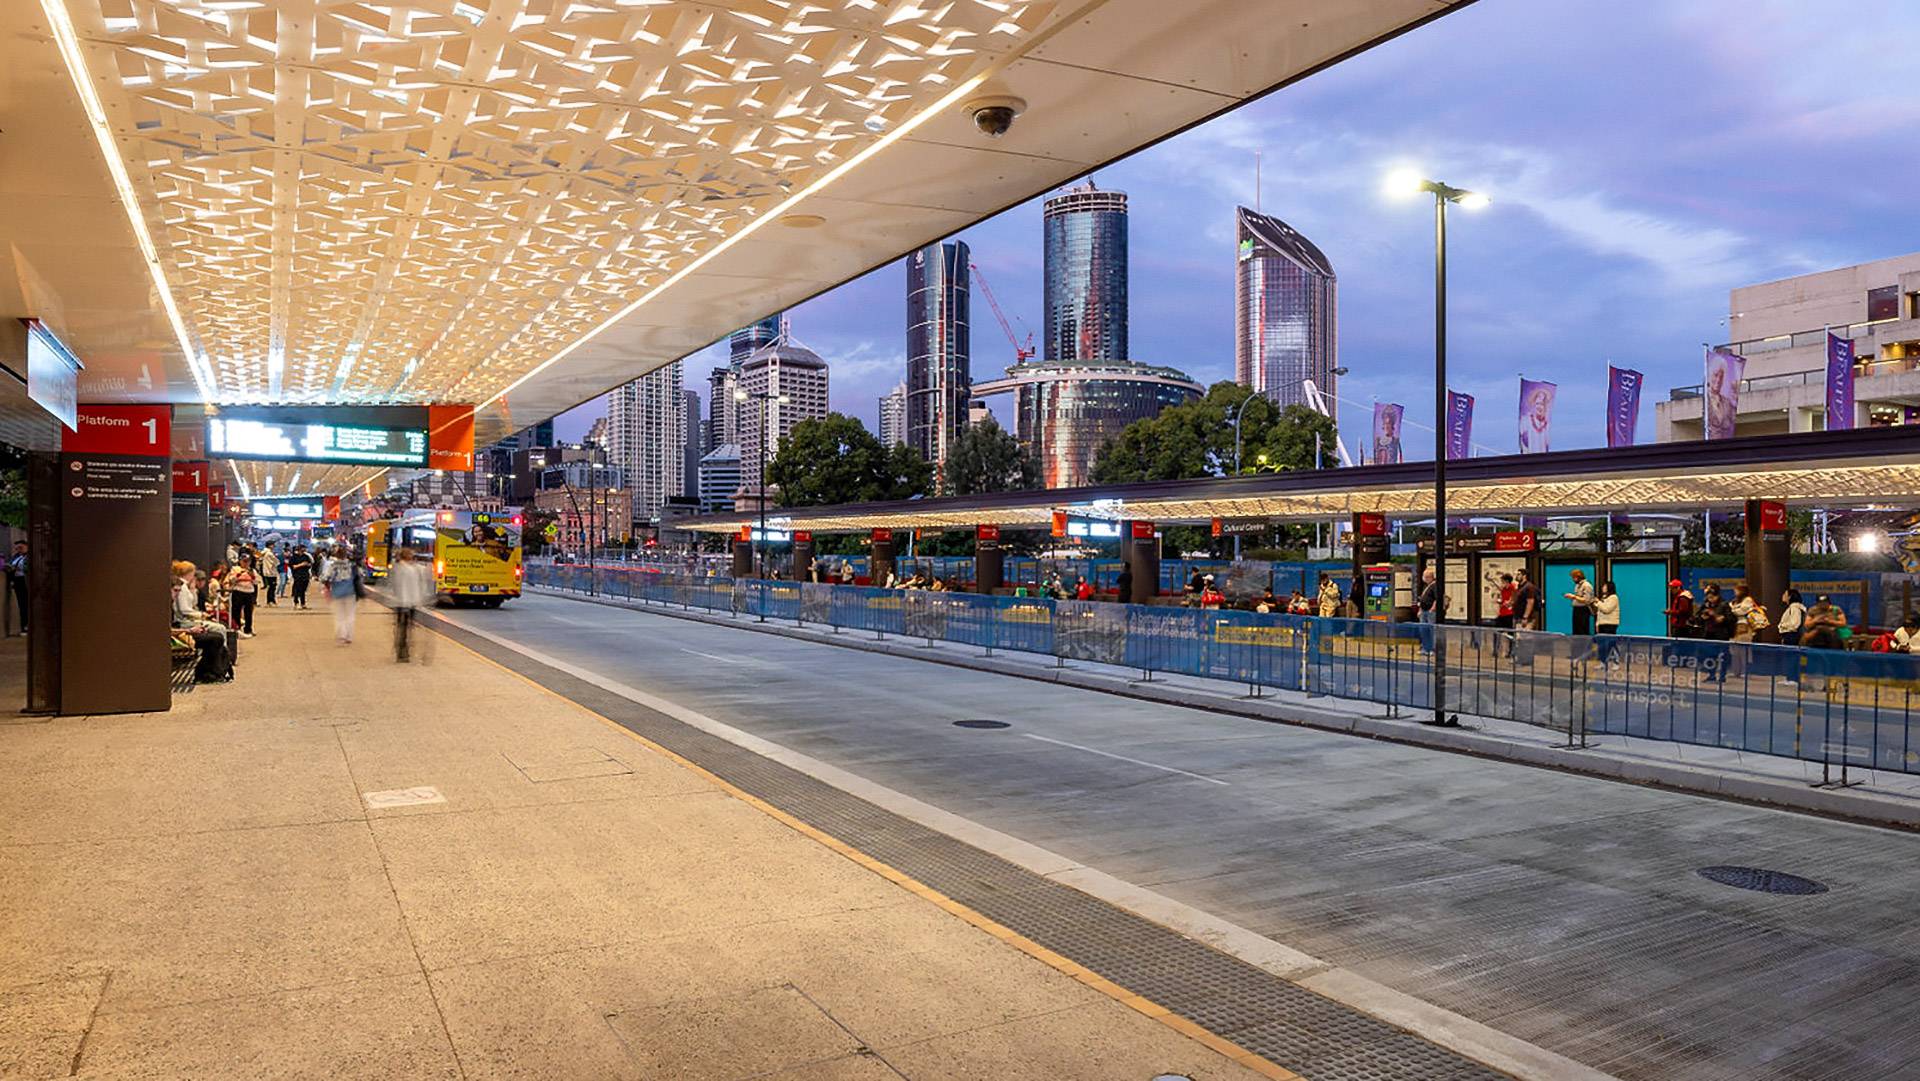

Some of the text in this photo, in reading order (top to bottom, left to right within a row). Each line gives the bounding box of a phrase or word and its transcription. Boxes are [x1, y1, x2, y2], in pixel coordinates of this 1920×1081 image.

[78, 414, 157, 445] Platform 1
[464, 452, 471, 467] 1
[191, 469, 200, 487] 1
[212, 492, 219, 504] 1
[1778, 509, 1784, 524] 2
[1376, 519, 1384, 531] 2
[1522, 534, 1531, 547] 2
[1606, 646, 1724, 670] A new era of
[1607, 667, 1701, 688] connected
